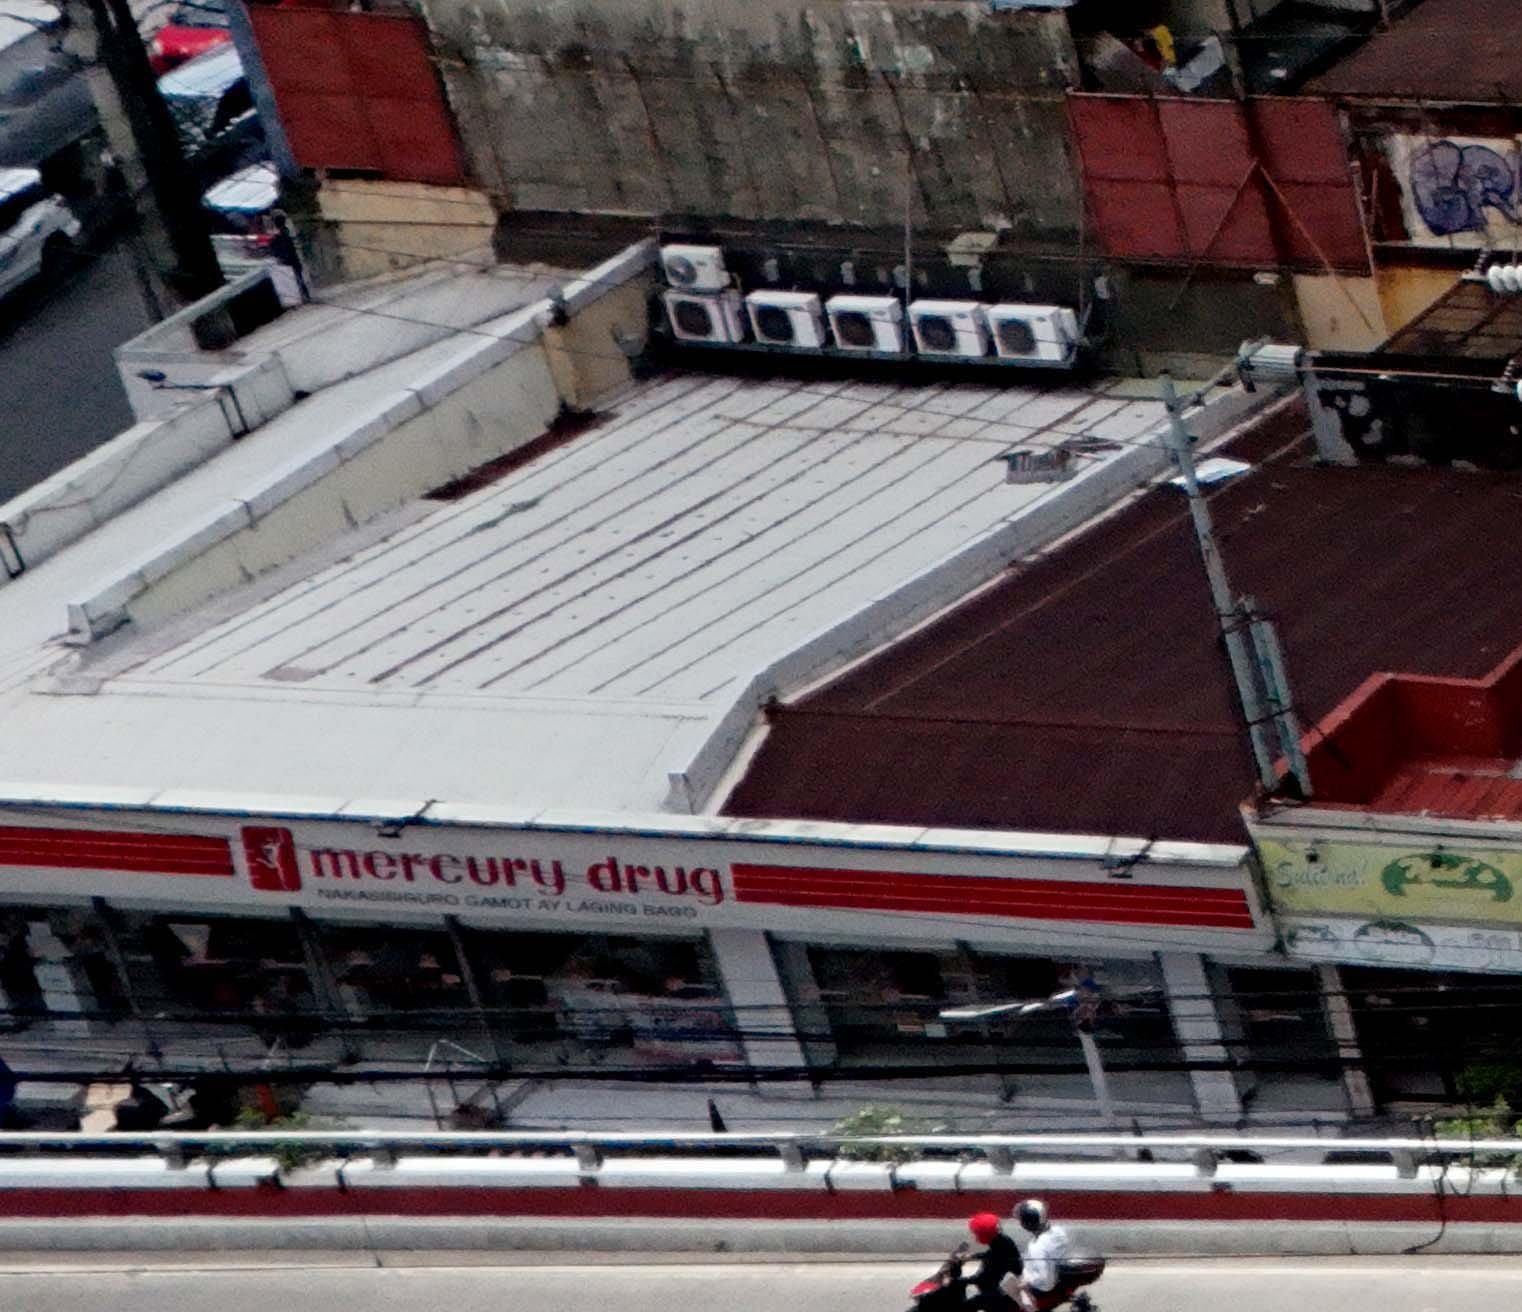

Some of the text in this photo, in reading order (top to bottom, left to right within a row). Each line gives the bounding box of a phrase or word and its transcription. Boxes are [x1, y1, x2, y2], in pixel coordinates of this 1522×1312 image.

[310, 847, 724, 906] mercury drug
[464, 897, 533, 909] GAMOT
[537, 899, 561, 911] AY
[566, 901, 637, 915] LAGING
[641, 905, 699, 918] BAGO
